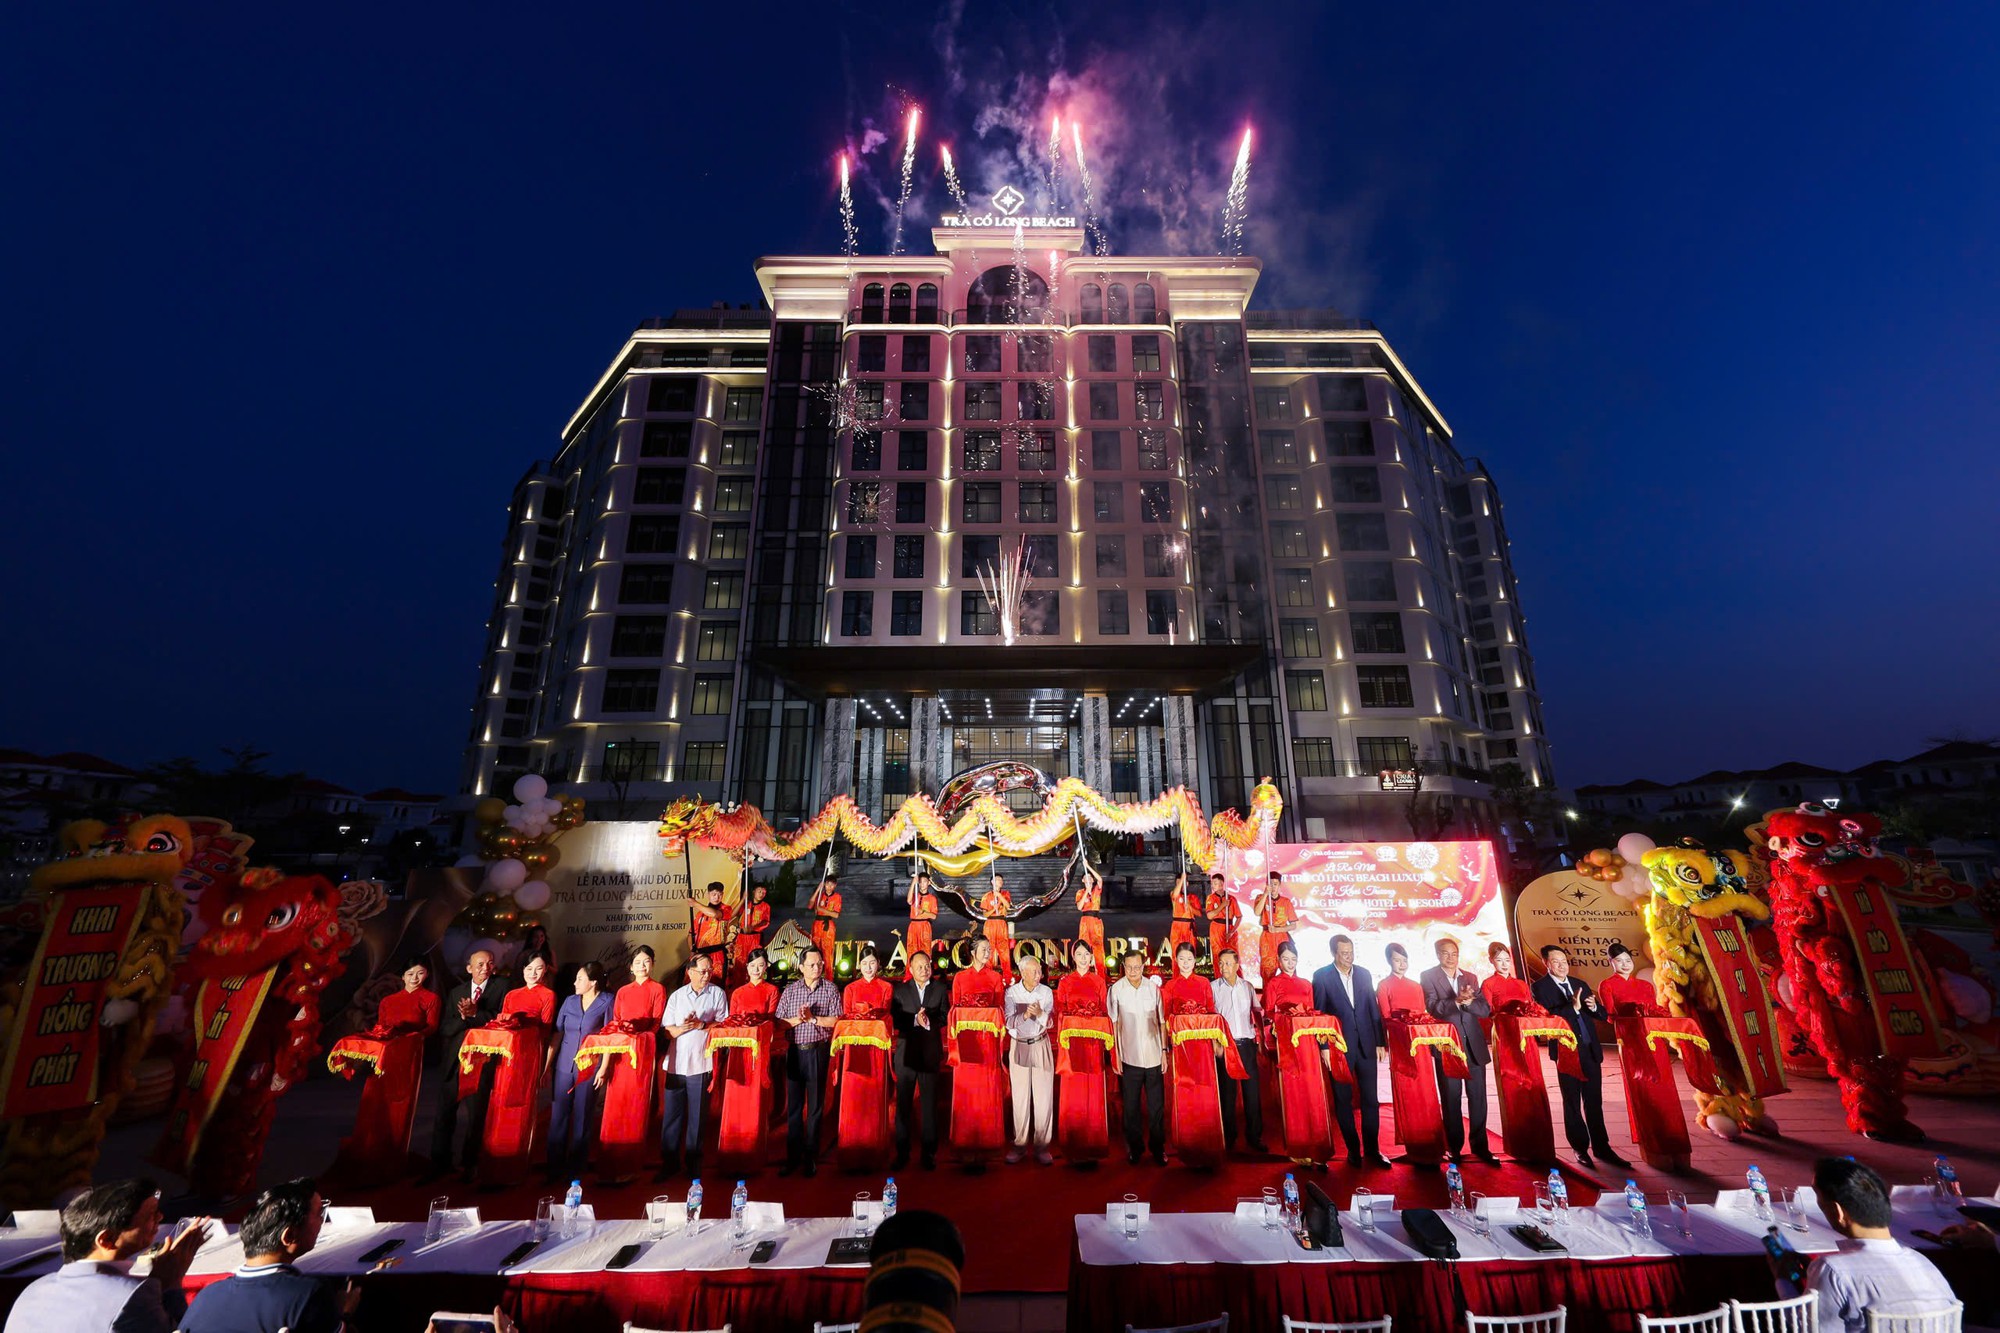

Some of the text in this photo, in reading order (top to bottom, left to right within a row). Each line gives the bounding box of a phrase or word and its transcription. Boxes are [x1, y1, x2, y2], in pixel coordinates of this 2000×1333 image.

[942, 213, 1075, 227] TRÀ CỔ LONG BEACH
[577, 872, 590, 887] LỄ
[592, 875, 606, 886] RA
[608, 872, 632, 886] MẮT
[633, 874, 655, 885] KHU
[656, 871, 671, 885] ĐÔ
[1291, 874, 1310, 882] TR
[1326, 874, 1355, 882] LONG
[1356, 874, 1390, 882] BEACH
[1392, 874, 1434, 882] LUXU
[554, 888, 576, 903] TRÀ
[597, 890, 627, 901] LONG
[630, 889, 664, 901] BEACH
[1398, 899, 1406, 907] &
[606, 914, 624, 922] KHAI
[1531, 908, 1552, 916] TRÀ
[1553, 908, 1569, 916] CỔ
[70, 905, 121, 934] KHAI
[592, 925, 610, 933] LONG
[611, 924, 632, 932] BEACH
[633, 923, 654, 931] HOTEL
[662, 922, 687, 930] RESORT
[1558, 935, 1622, 947] KIẾN TẠO
[1573, 948, 1596, 958] TRỊ
[1599, 948, 1639, 957] SG
[43, 952, 118, 985] TRƯƠNG
[38, 988, 95, 1036] HỒNG
[28, 1045, 82, 1088] PHÁT
